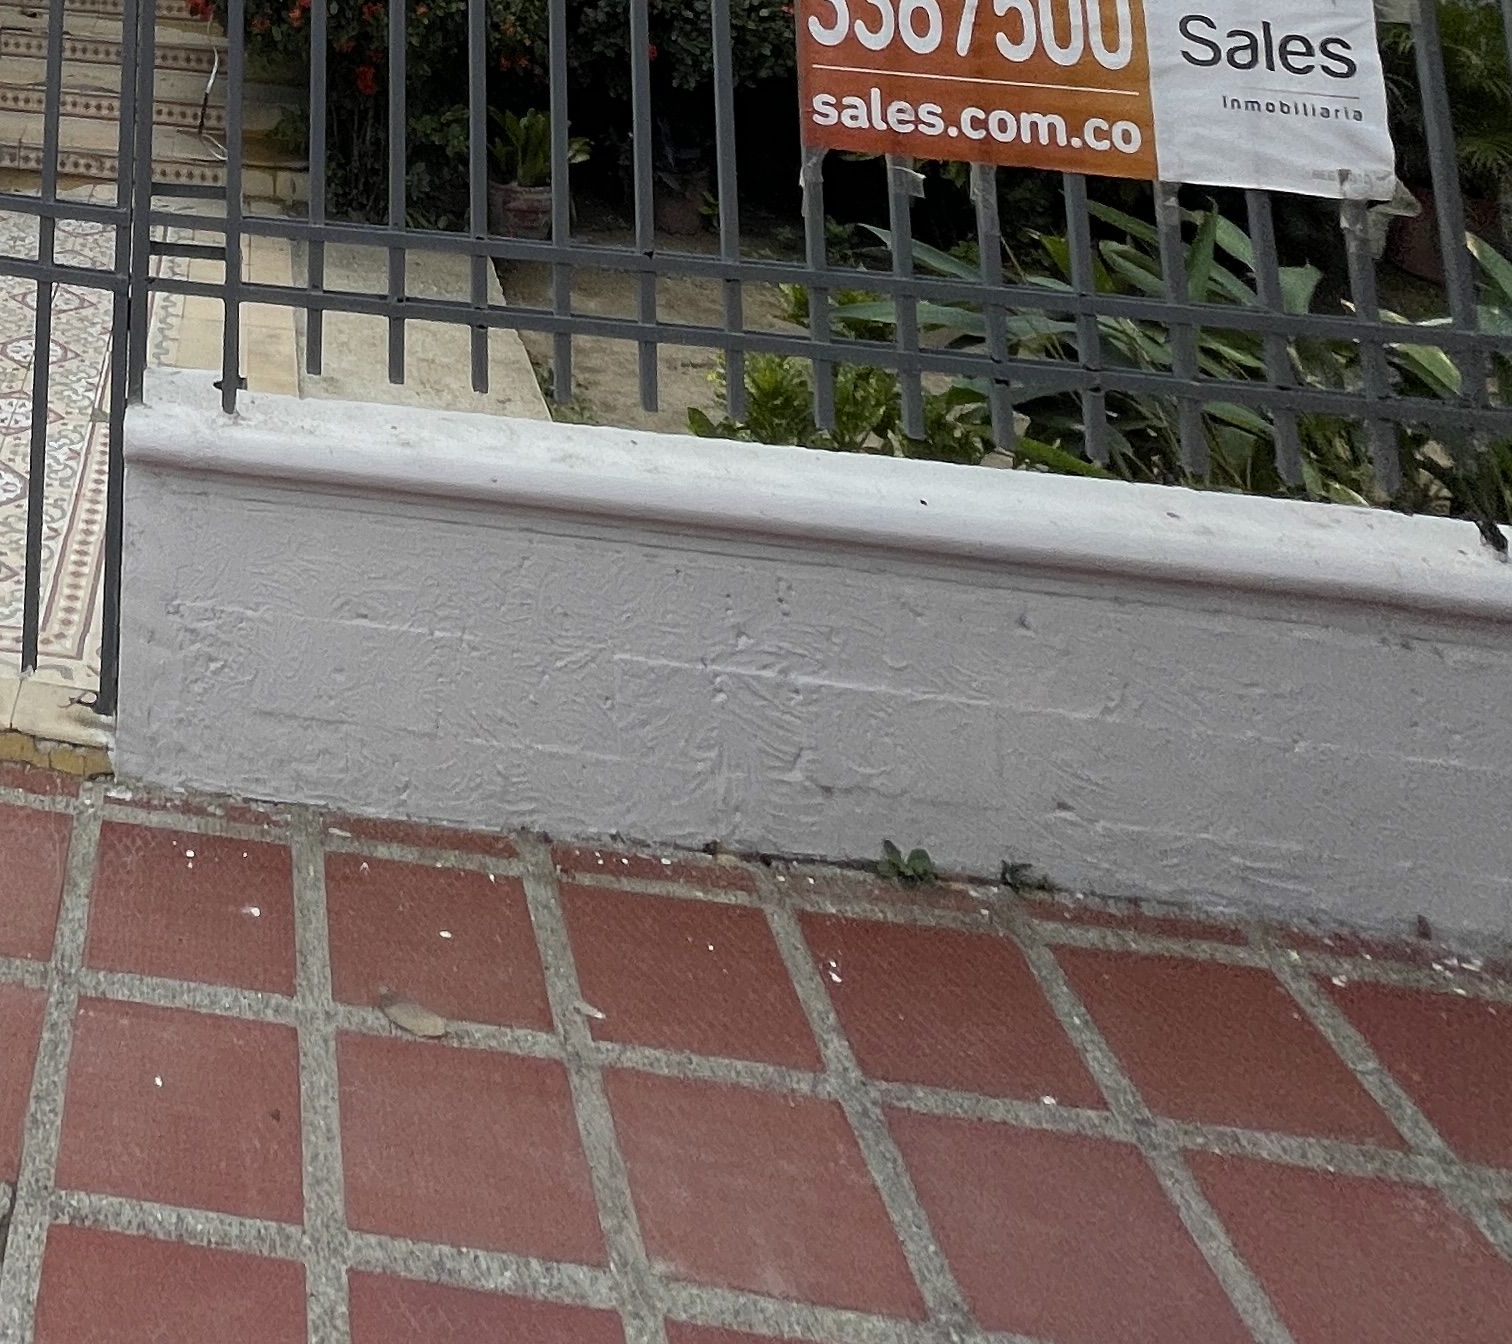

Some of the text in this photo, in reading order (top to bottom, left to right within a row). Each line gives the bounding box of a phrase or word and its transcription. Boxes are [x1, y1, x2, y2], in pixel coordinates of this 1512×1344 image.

[1178, 14, 1357, 79] Sales
[811, 87, 1143, 155] sales.com.co
[1221, 95, 1364, 123] Inmobiliaria
